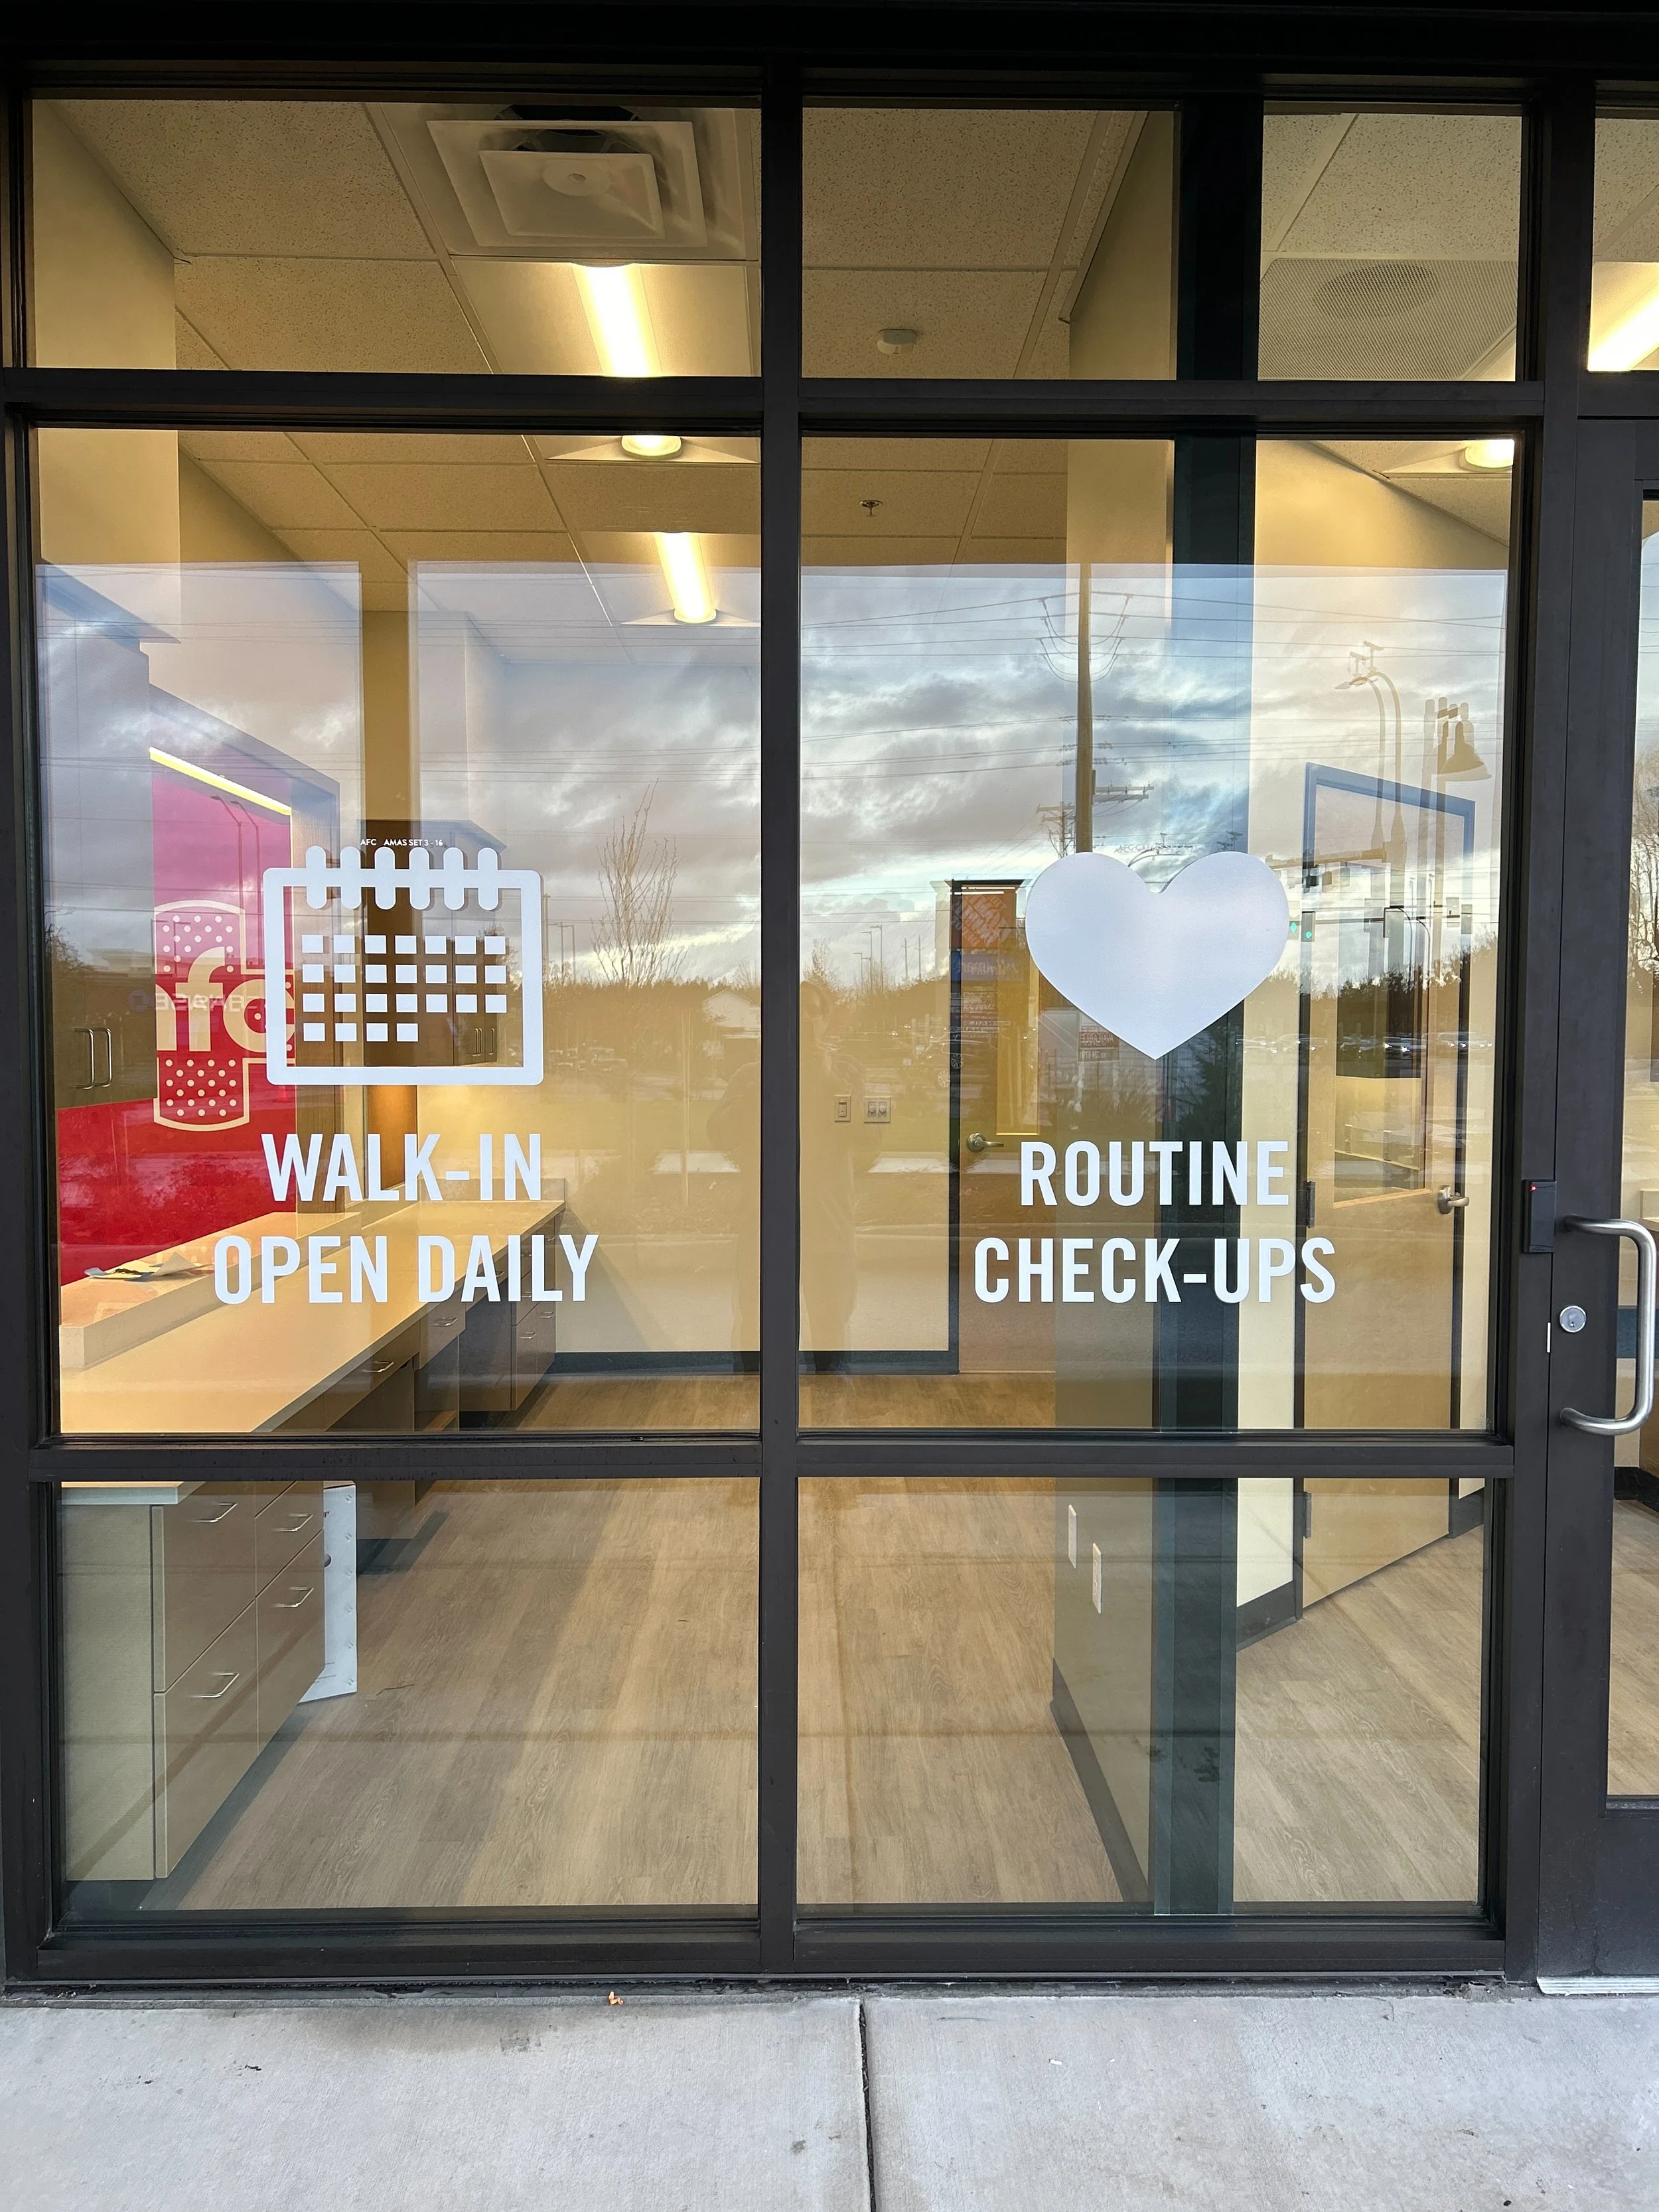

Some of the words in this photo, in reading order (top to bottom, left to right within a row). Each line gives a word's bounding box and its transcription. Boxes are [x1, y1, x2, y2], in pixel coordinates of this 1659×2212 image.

[261, 1134, 541, 1201] WALK-IN
[1021, 1140, 1289, 1207] ROUTINE
[214, 1236, 387, 1304] OPEN
[418, 1234, 598, 1303] DAILY
[975, 1236, 1336, 1303] CHECK-UPS
